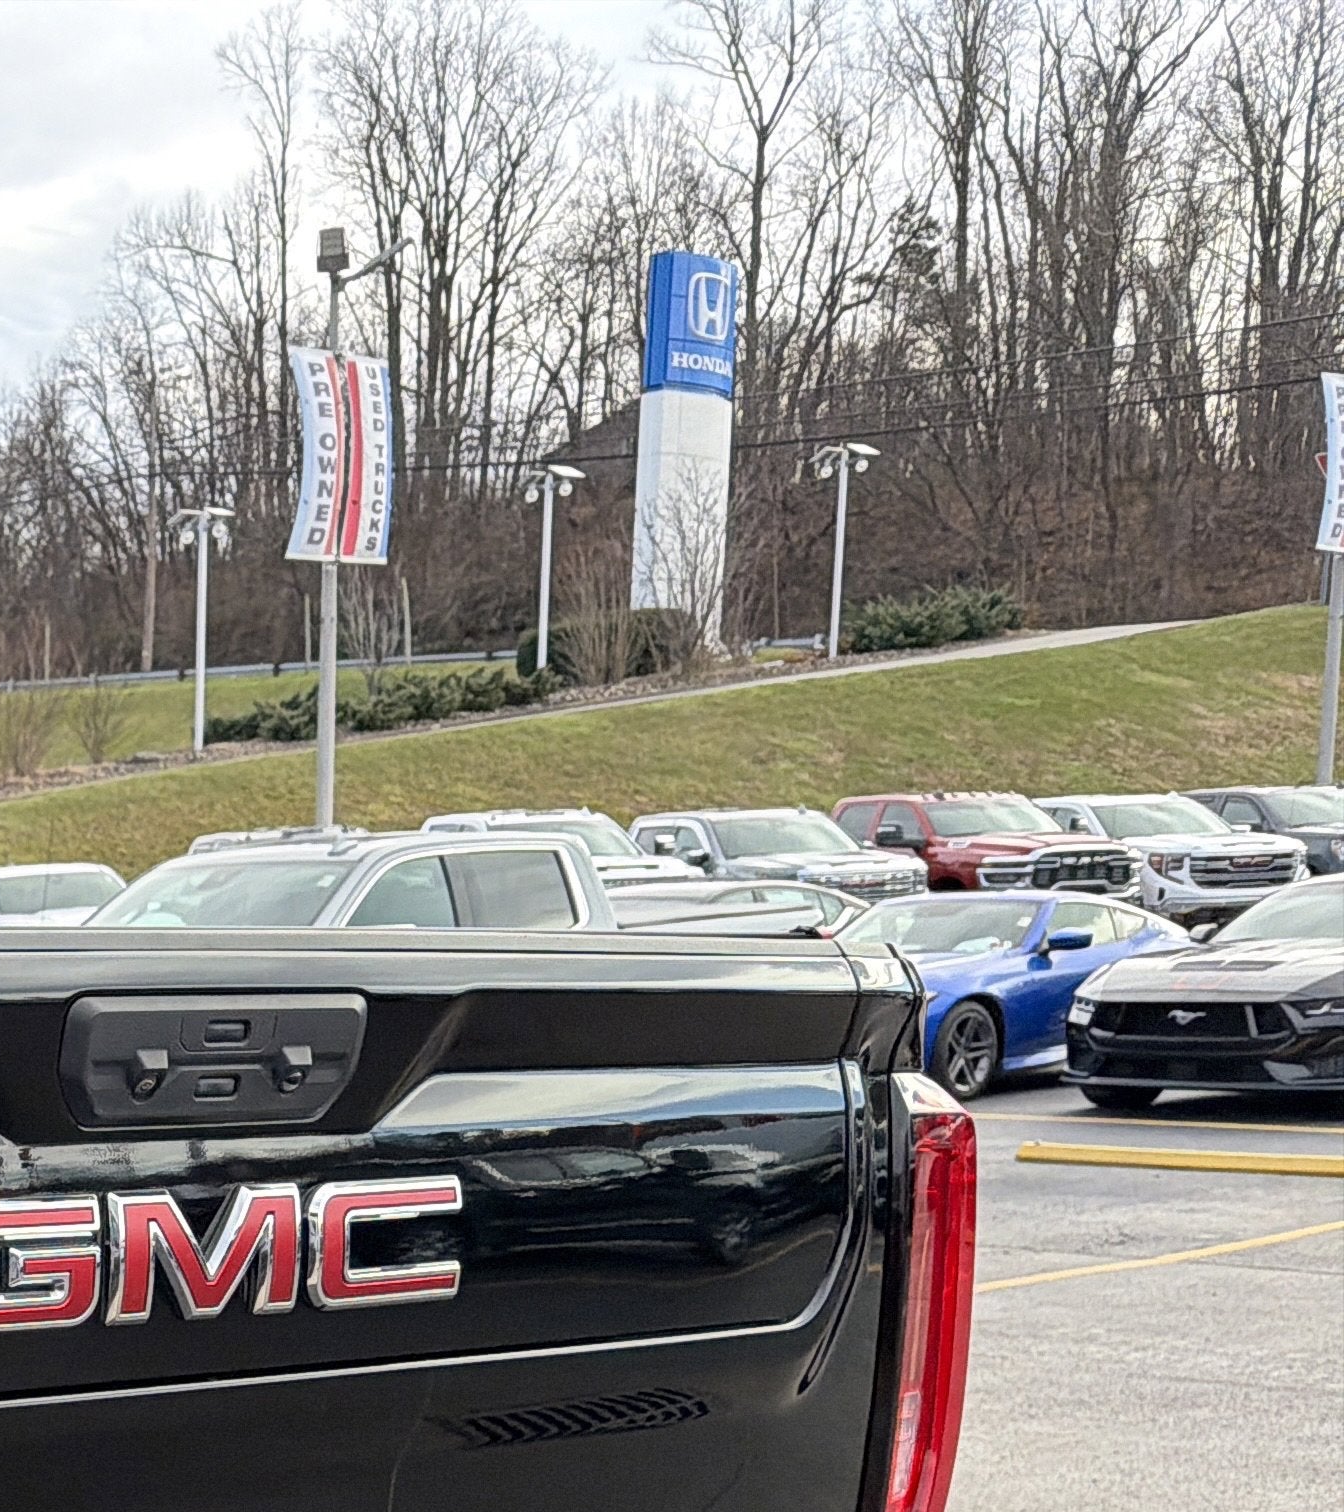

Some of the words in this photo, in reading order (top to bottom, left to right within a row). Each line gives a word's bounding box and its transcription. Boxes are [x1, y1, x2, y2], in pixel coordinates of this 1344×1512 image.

[307, 361, 334, 419] PRE
[364, 365, 386, 433] USED
[671, 351, 733, 379] HONDA
[307, 432, 337, 547] OWNED
[364, 443, 386, 553] TRUCKS
